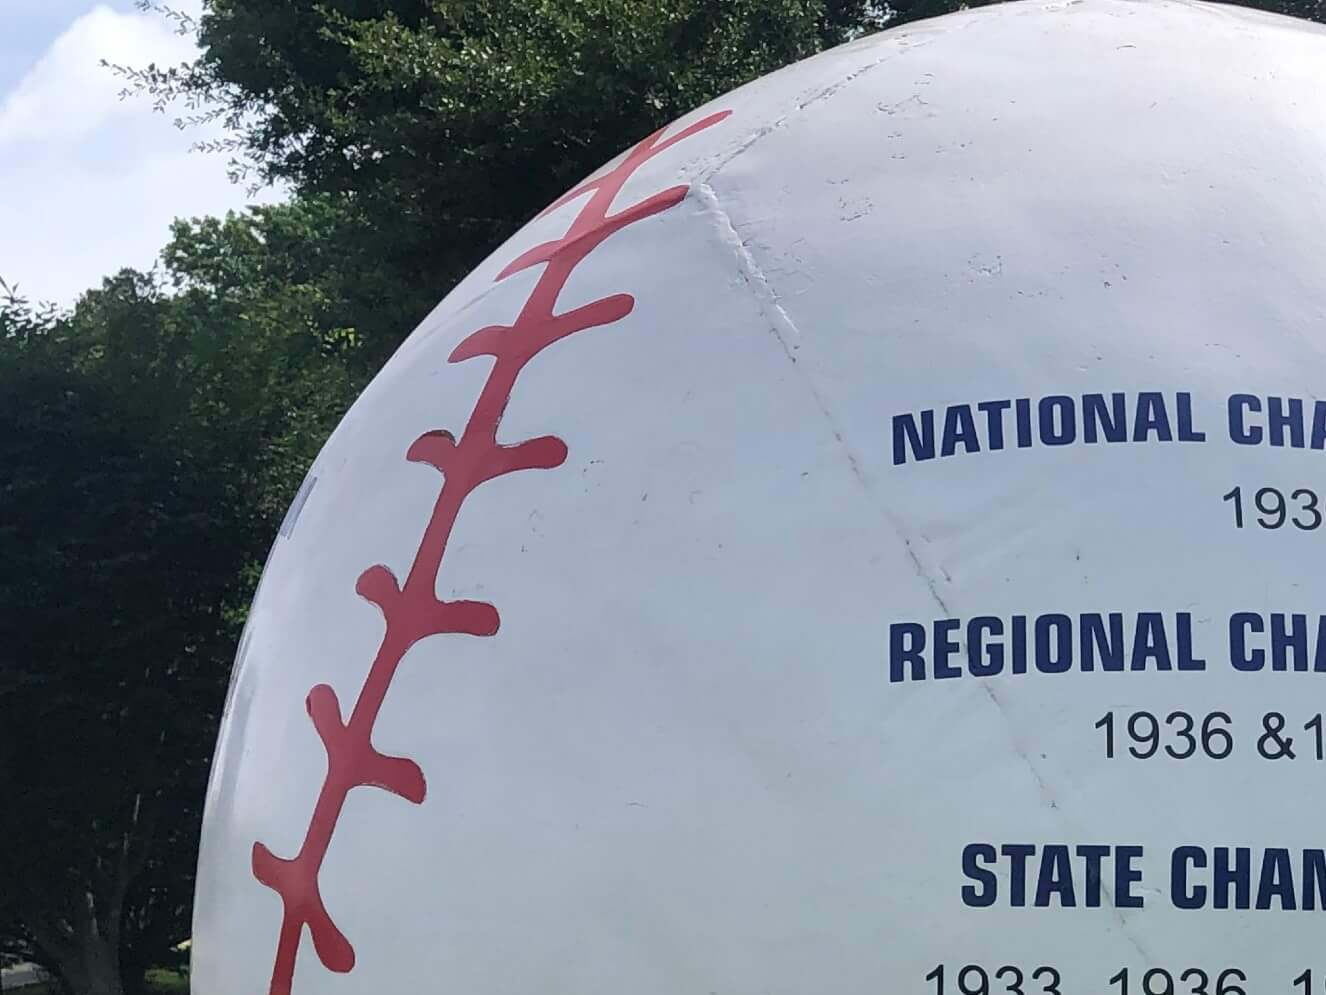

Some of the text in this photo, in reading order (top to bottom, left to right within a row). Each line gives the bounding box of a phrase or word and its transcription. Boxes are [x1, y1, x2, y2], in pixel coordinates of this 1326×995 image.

[892, 391, 1206, 467] NATIONAL
[889, 612, 1207, 684] REGIONAL
[1095, 710, 1235, 761] 1936
[961, 843, 1147, 910] STATE
